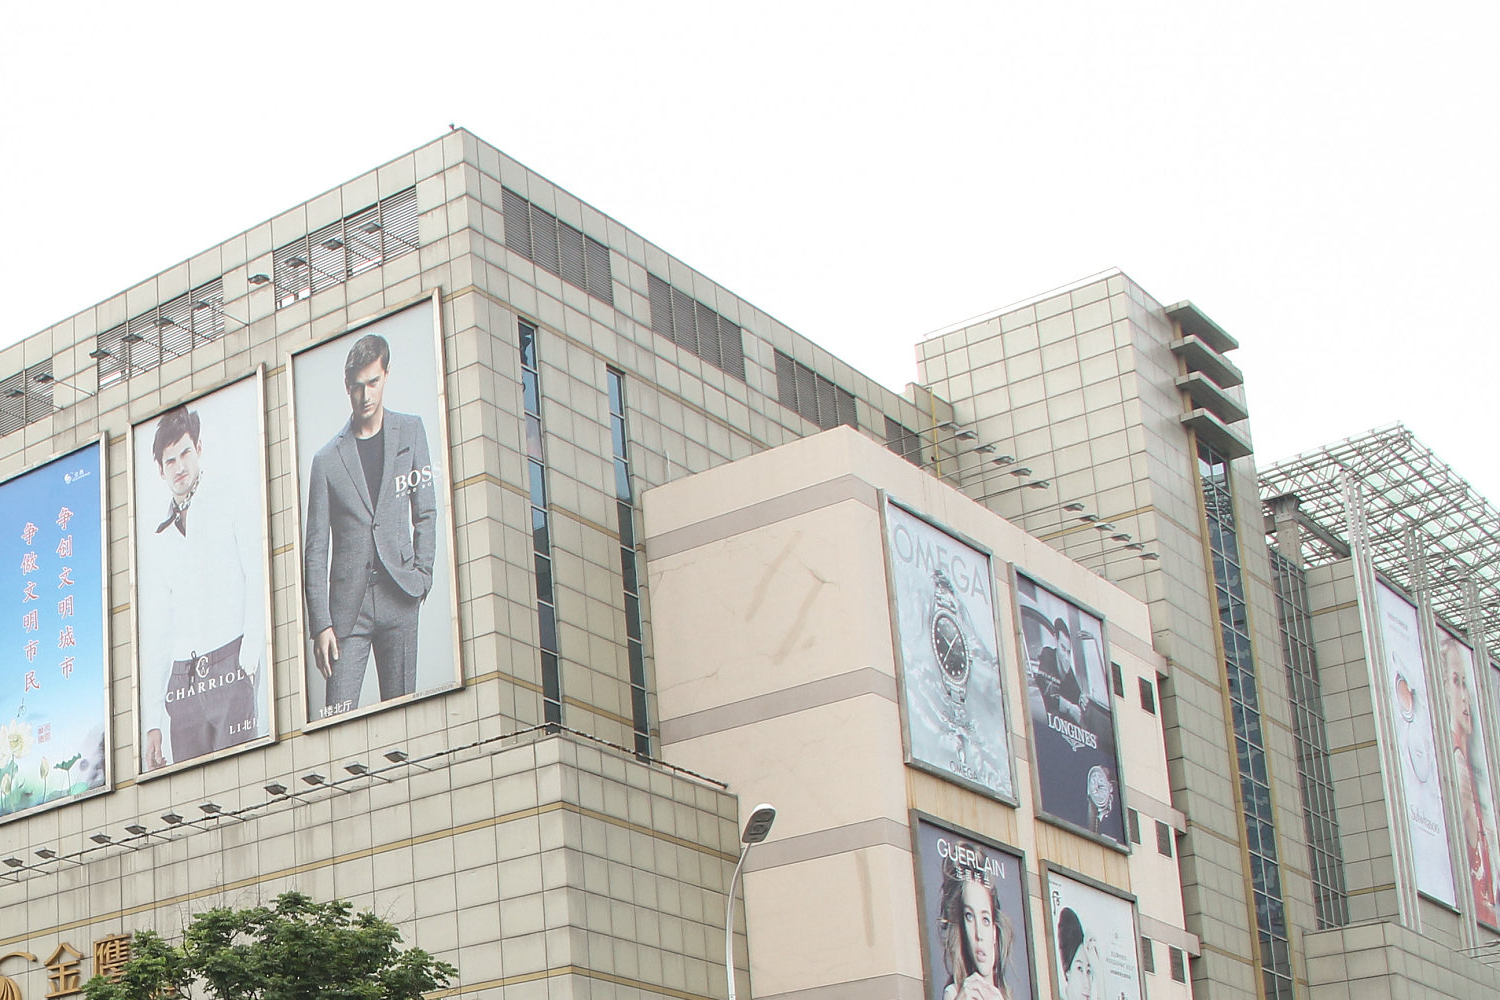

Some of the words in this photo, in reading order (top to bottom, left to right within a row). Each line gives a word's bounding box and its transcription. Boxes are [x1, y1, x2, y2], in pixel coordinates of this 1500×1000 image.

[56, 506, 76, 680] 争创文明城市
[894, 523, 989, 606] OMEGA
[20, 521, 41, 694] 争做文明市民
[165, 669, 245, 703] CHARRIOL
[1047, 712, 1098, 750] LONGINES
[936, 838, 1005, 880] GUERLAIN
